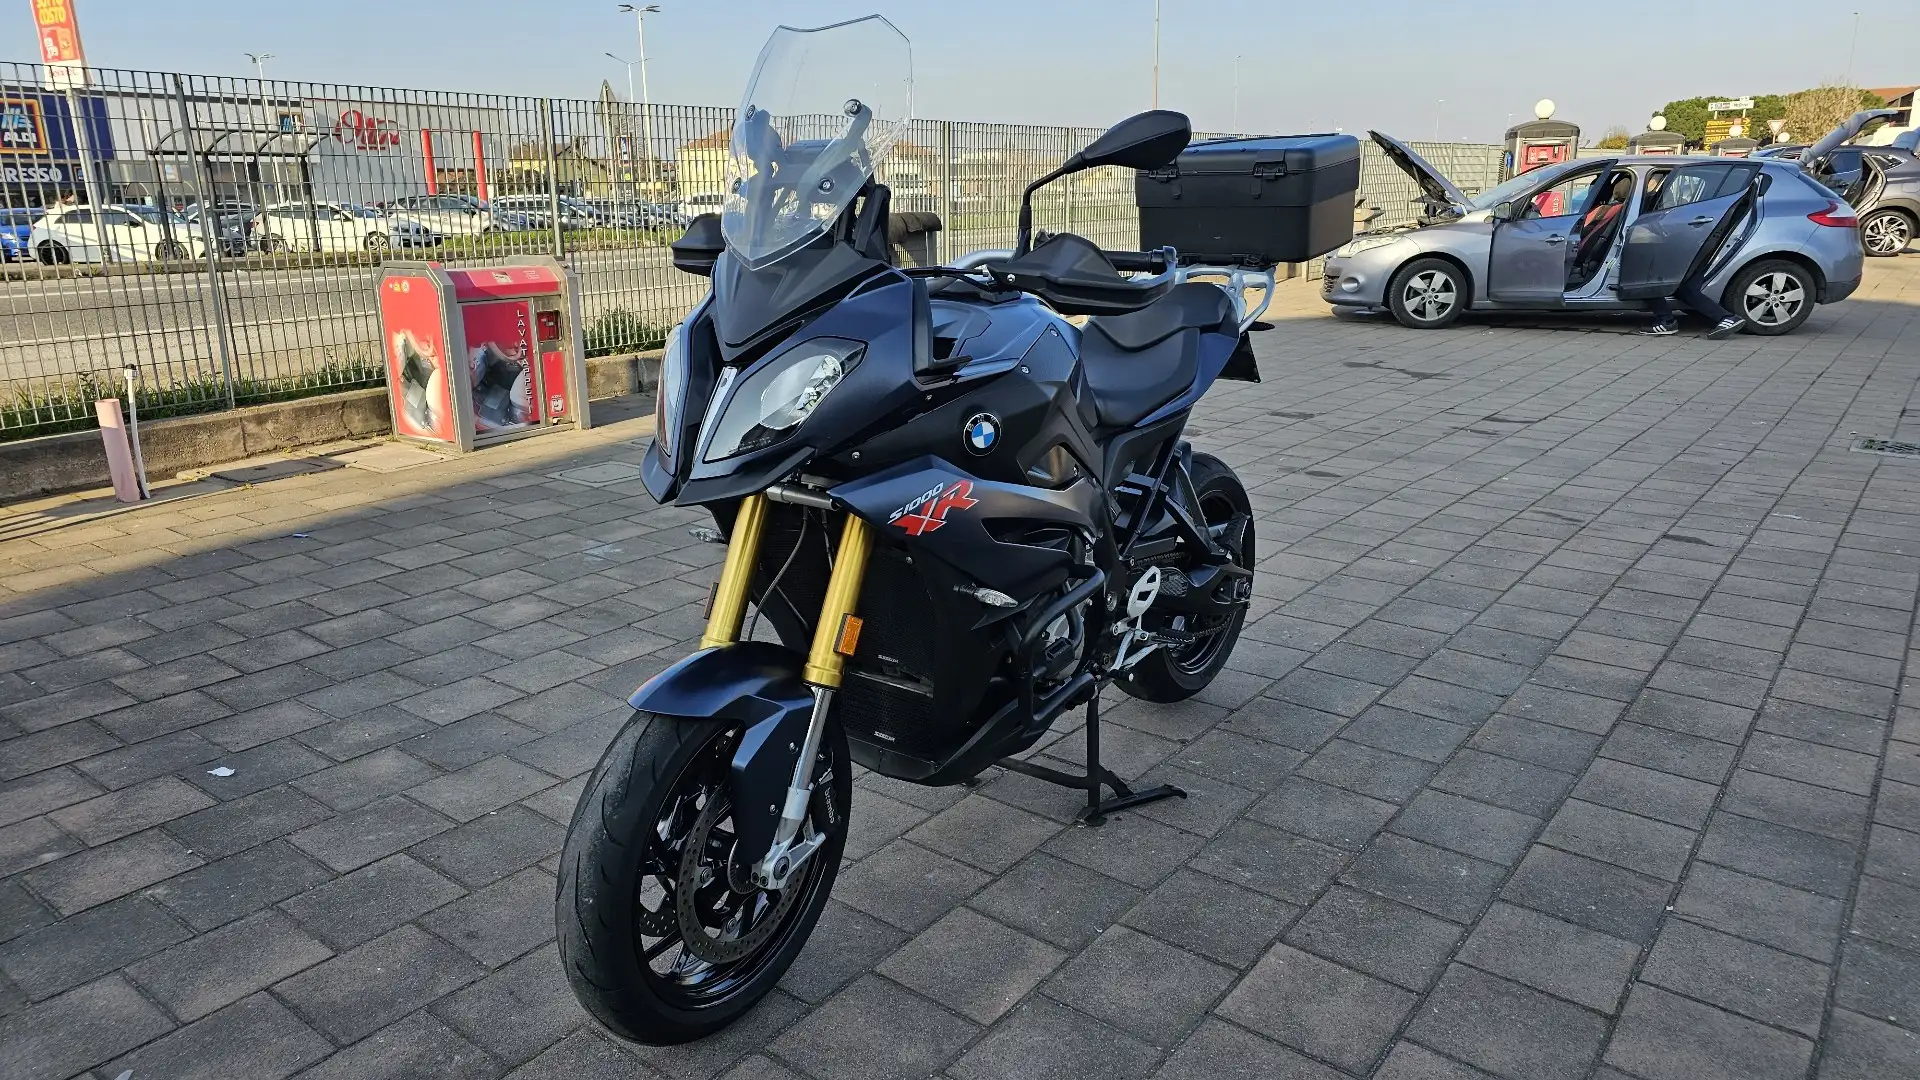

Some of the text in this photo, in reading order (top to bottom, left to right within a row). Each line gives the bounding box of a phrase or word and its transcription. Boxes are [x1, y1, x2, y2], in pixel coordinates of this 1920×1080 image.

[3, 131, 38, 143] ALDI
[0, 167, 63, 183] RESSO
[887, 482, 944, 524] S1000
[891, 479, 980, 536] XR
